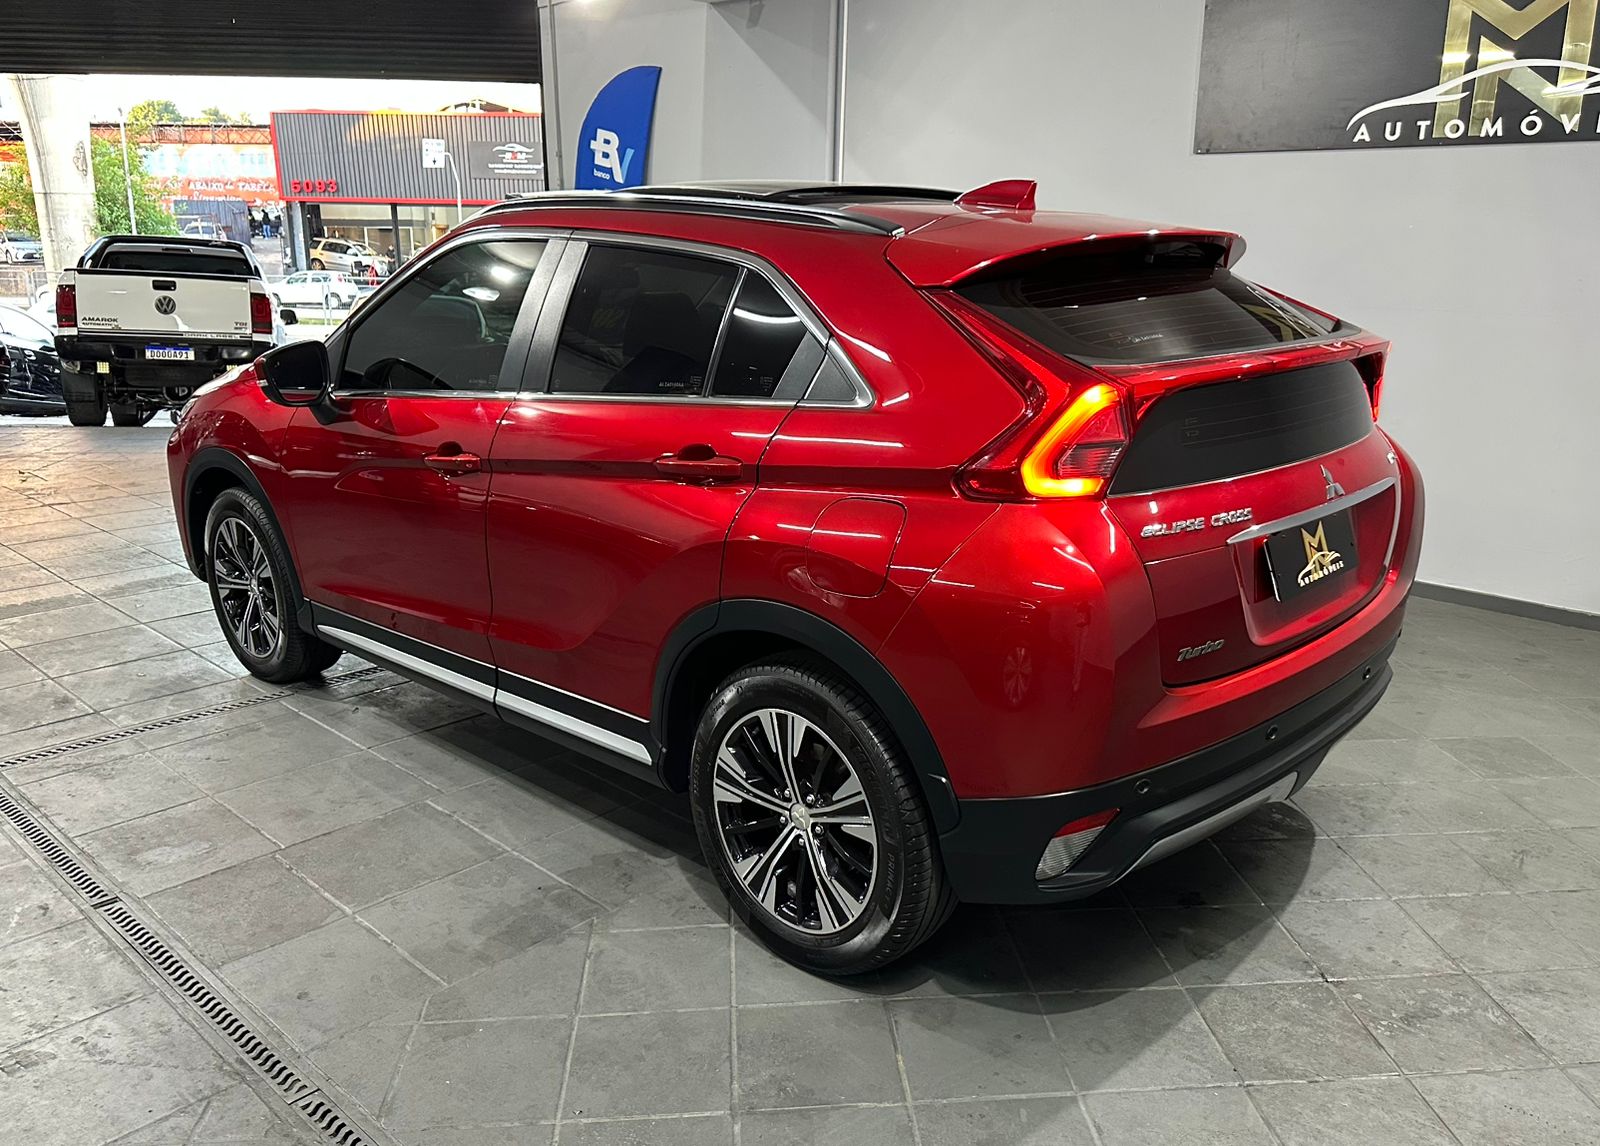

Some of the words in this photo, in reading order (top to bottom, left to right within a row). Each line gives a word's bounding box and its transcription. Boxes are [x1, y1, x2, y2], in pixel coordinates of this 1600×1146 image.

[1353, 109, 1600, 143] AUTOMÓV
[291, 179, 338, 193] 5093
[1141, 517, 1205, 537] ECLIPSE
[1211, 507, 1253, 527] CROSS
[1177, 639, 1225, 662] Turbo
